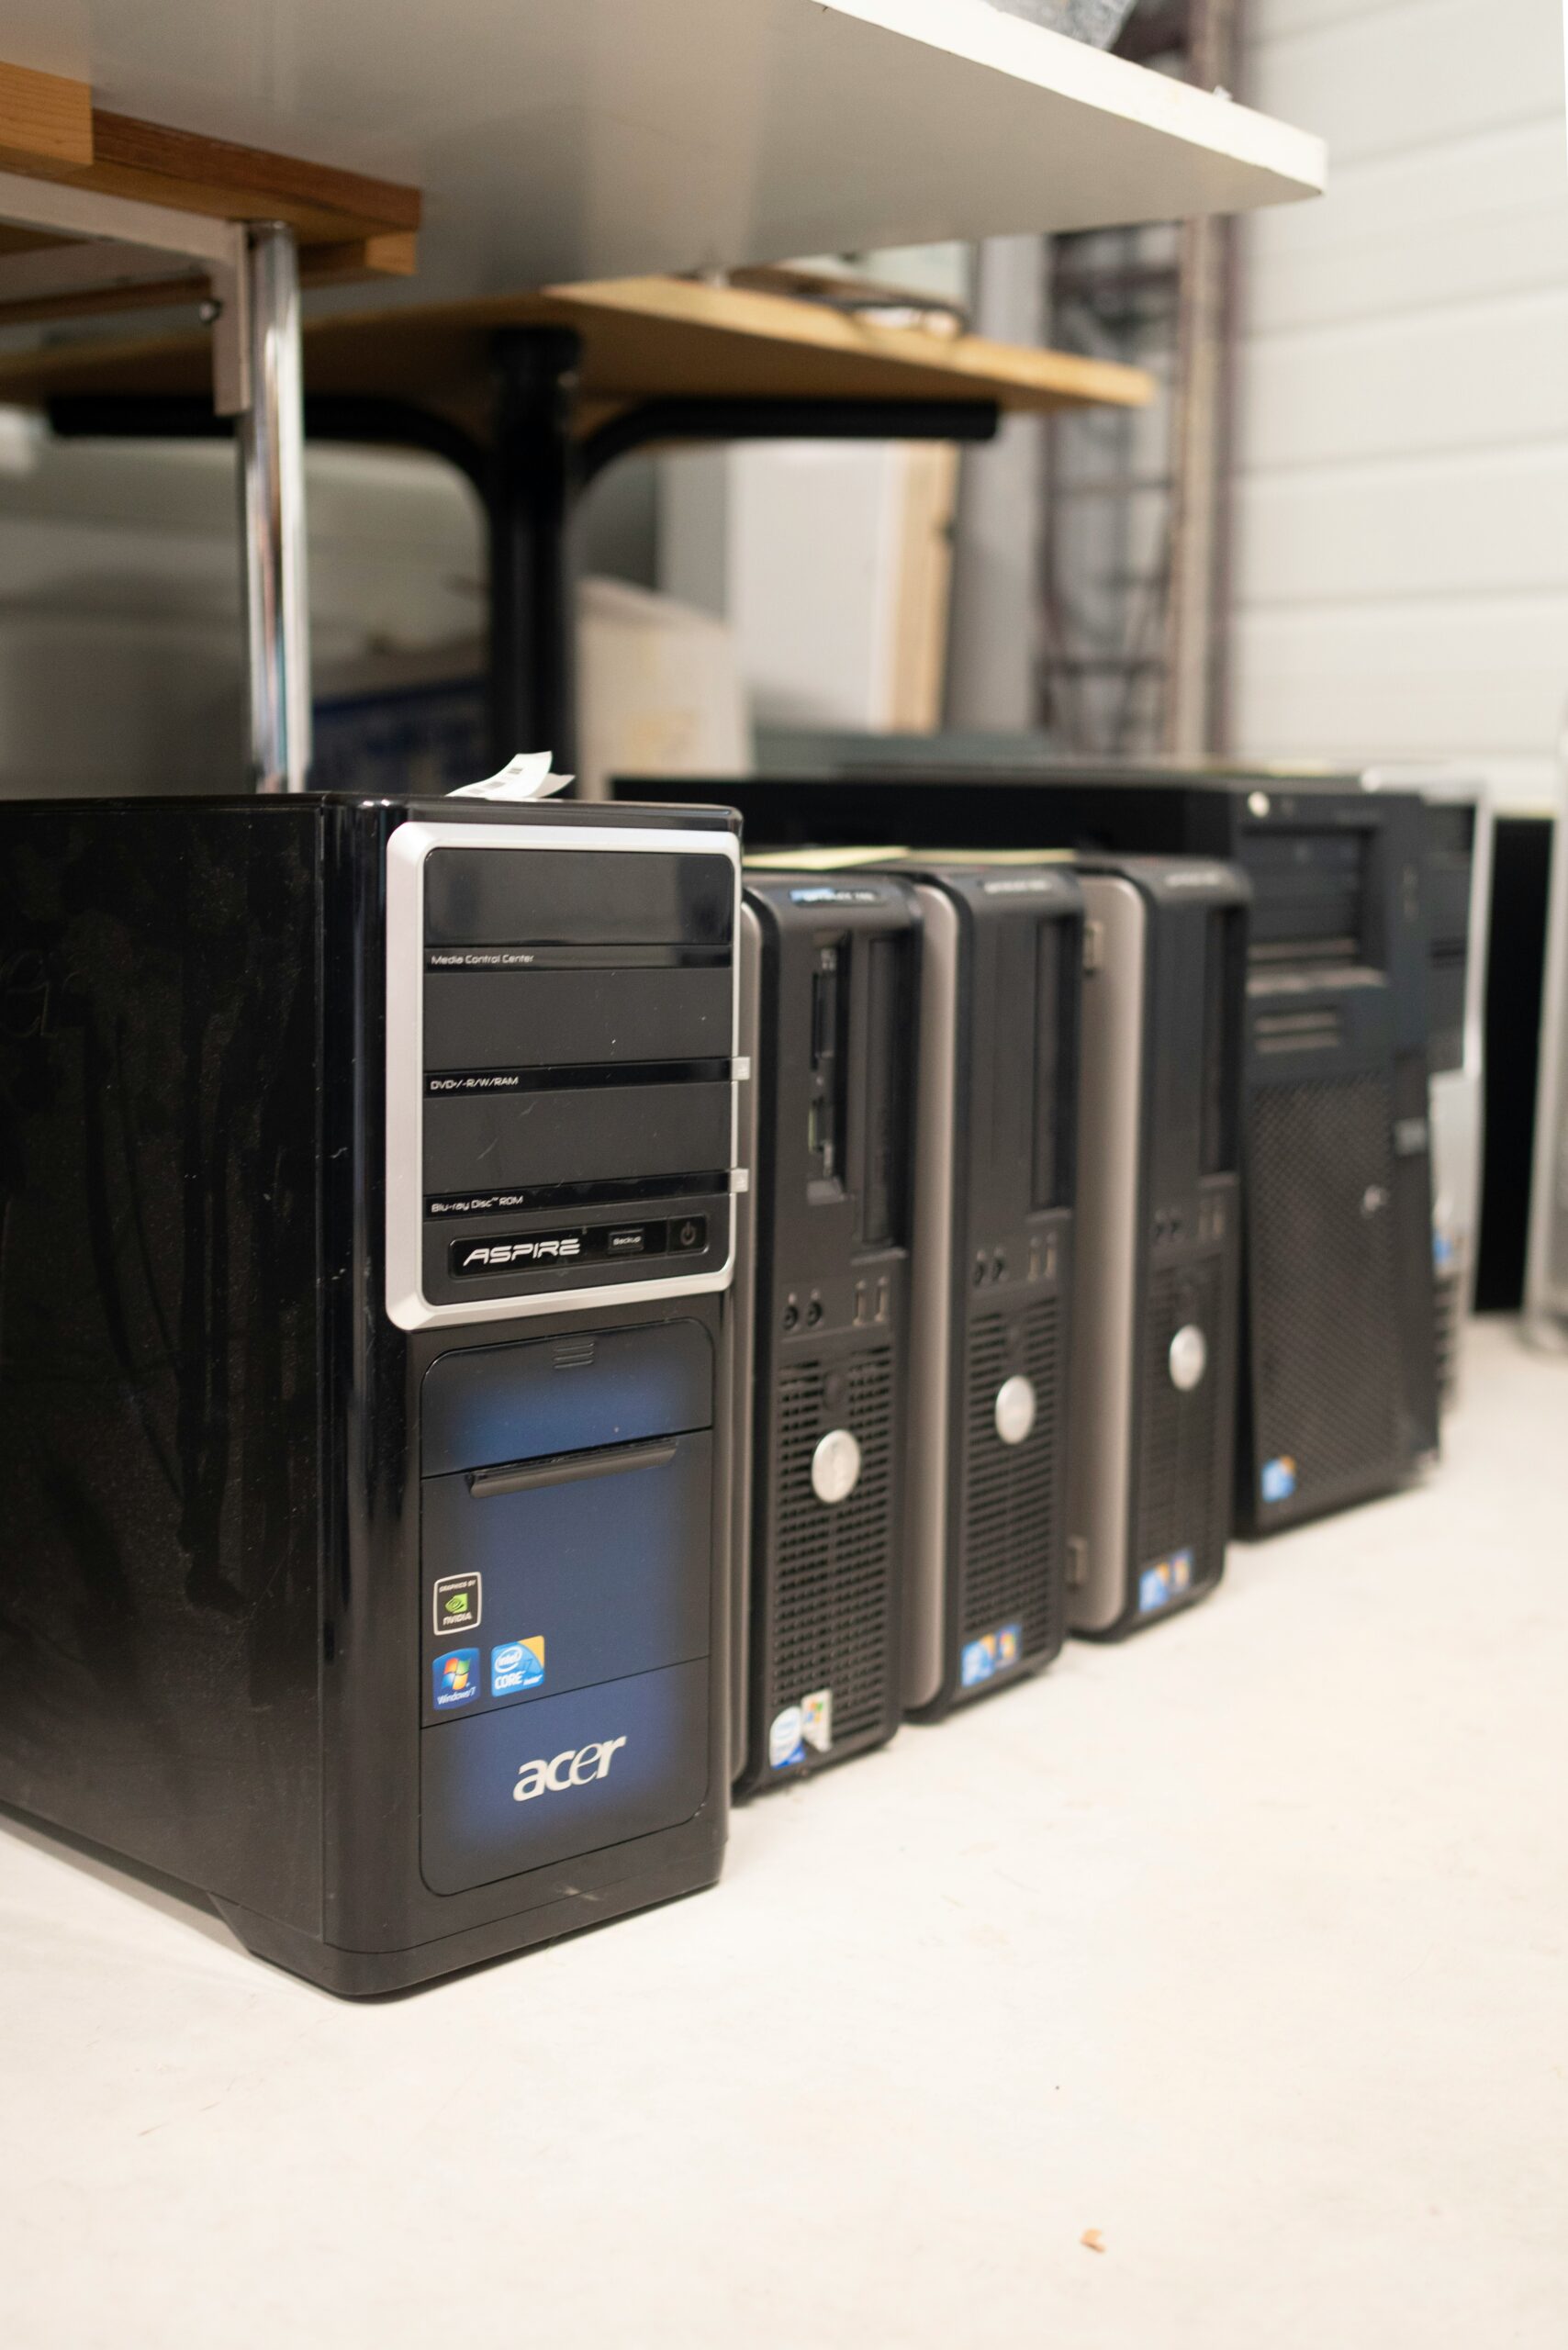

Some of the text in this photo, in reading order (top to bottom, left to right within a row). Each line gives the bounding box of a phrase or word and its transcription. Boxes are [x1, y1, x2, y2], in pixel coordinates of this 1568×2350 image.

[431, 954, 535, 965] Media Control Center
[431, 1203, 470, 1213] Blu-ray
[498, 1195, 523, 1205] ROM
[463, 1237, 581, 1267] ASPIRE
[512, 1736, 627, 1802] acer
